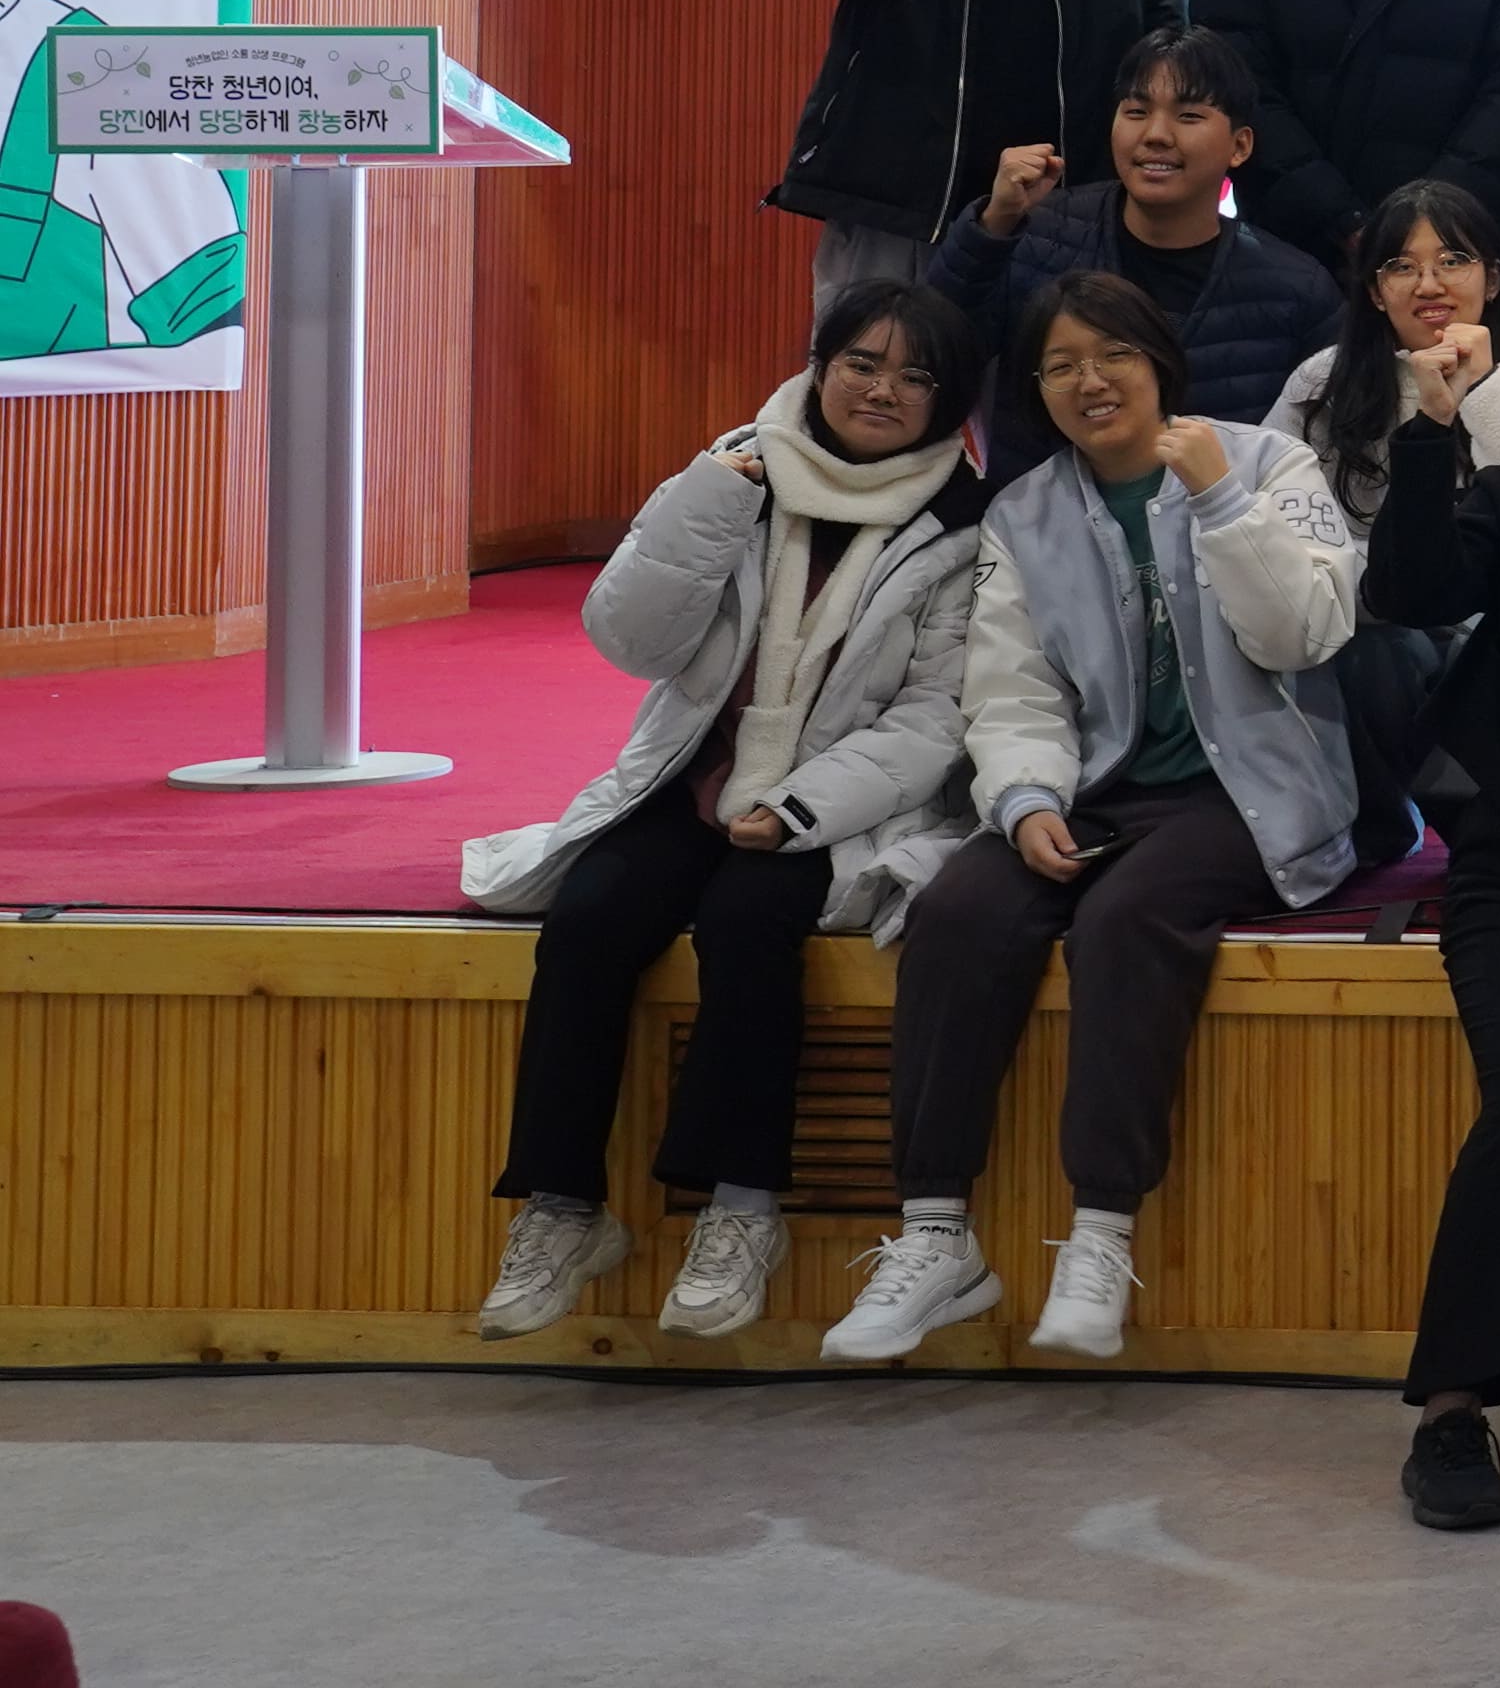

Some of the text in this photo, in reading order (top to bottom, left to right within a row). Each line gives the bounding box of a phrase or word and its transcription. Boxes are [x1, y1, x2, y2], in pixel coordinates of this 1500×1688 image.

[169, 75, 319, 101] 당찬 청년이여,
[99, 109, 389, 135] 당진에서 당당하게 창농하자
